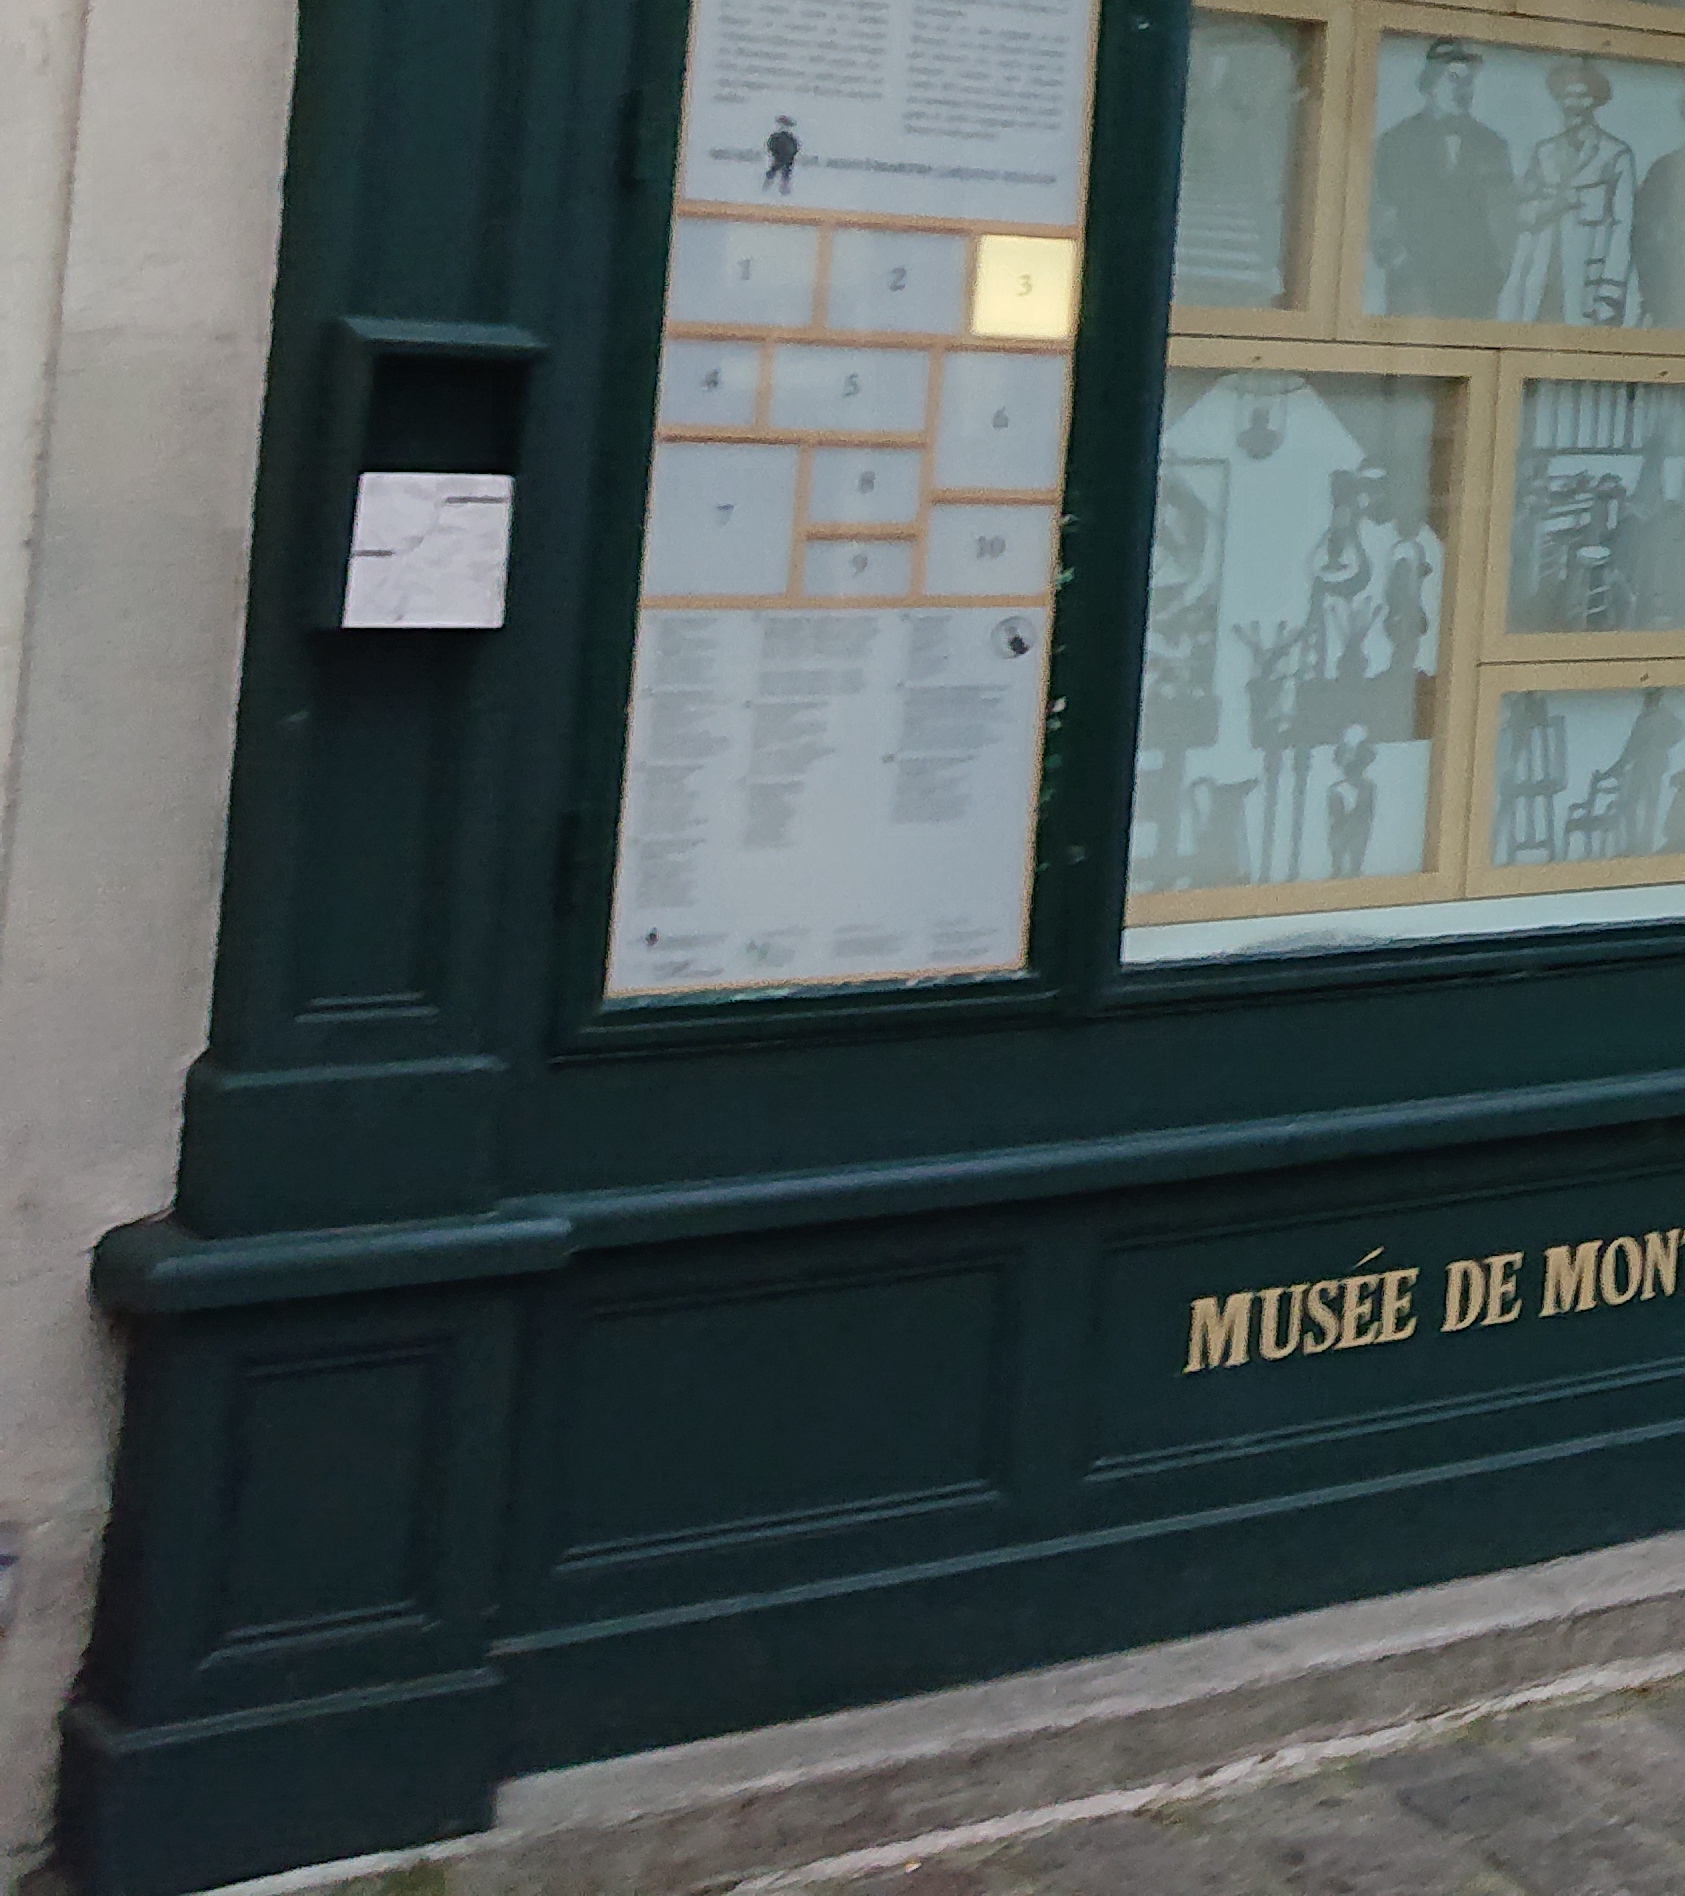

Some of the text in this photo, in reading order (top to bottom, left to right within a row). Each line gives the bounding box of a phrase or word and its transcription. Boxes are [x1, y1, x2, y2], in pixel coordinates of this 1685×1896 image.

[1018, 274, 1033, 297] 3
[1183, 1246, 1420, 1374] MUSÉE
[1440, 1251, 1526, 1332] DE
